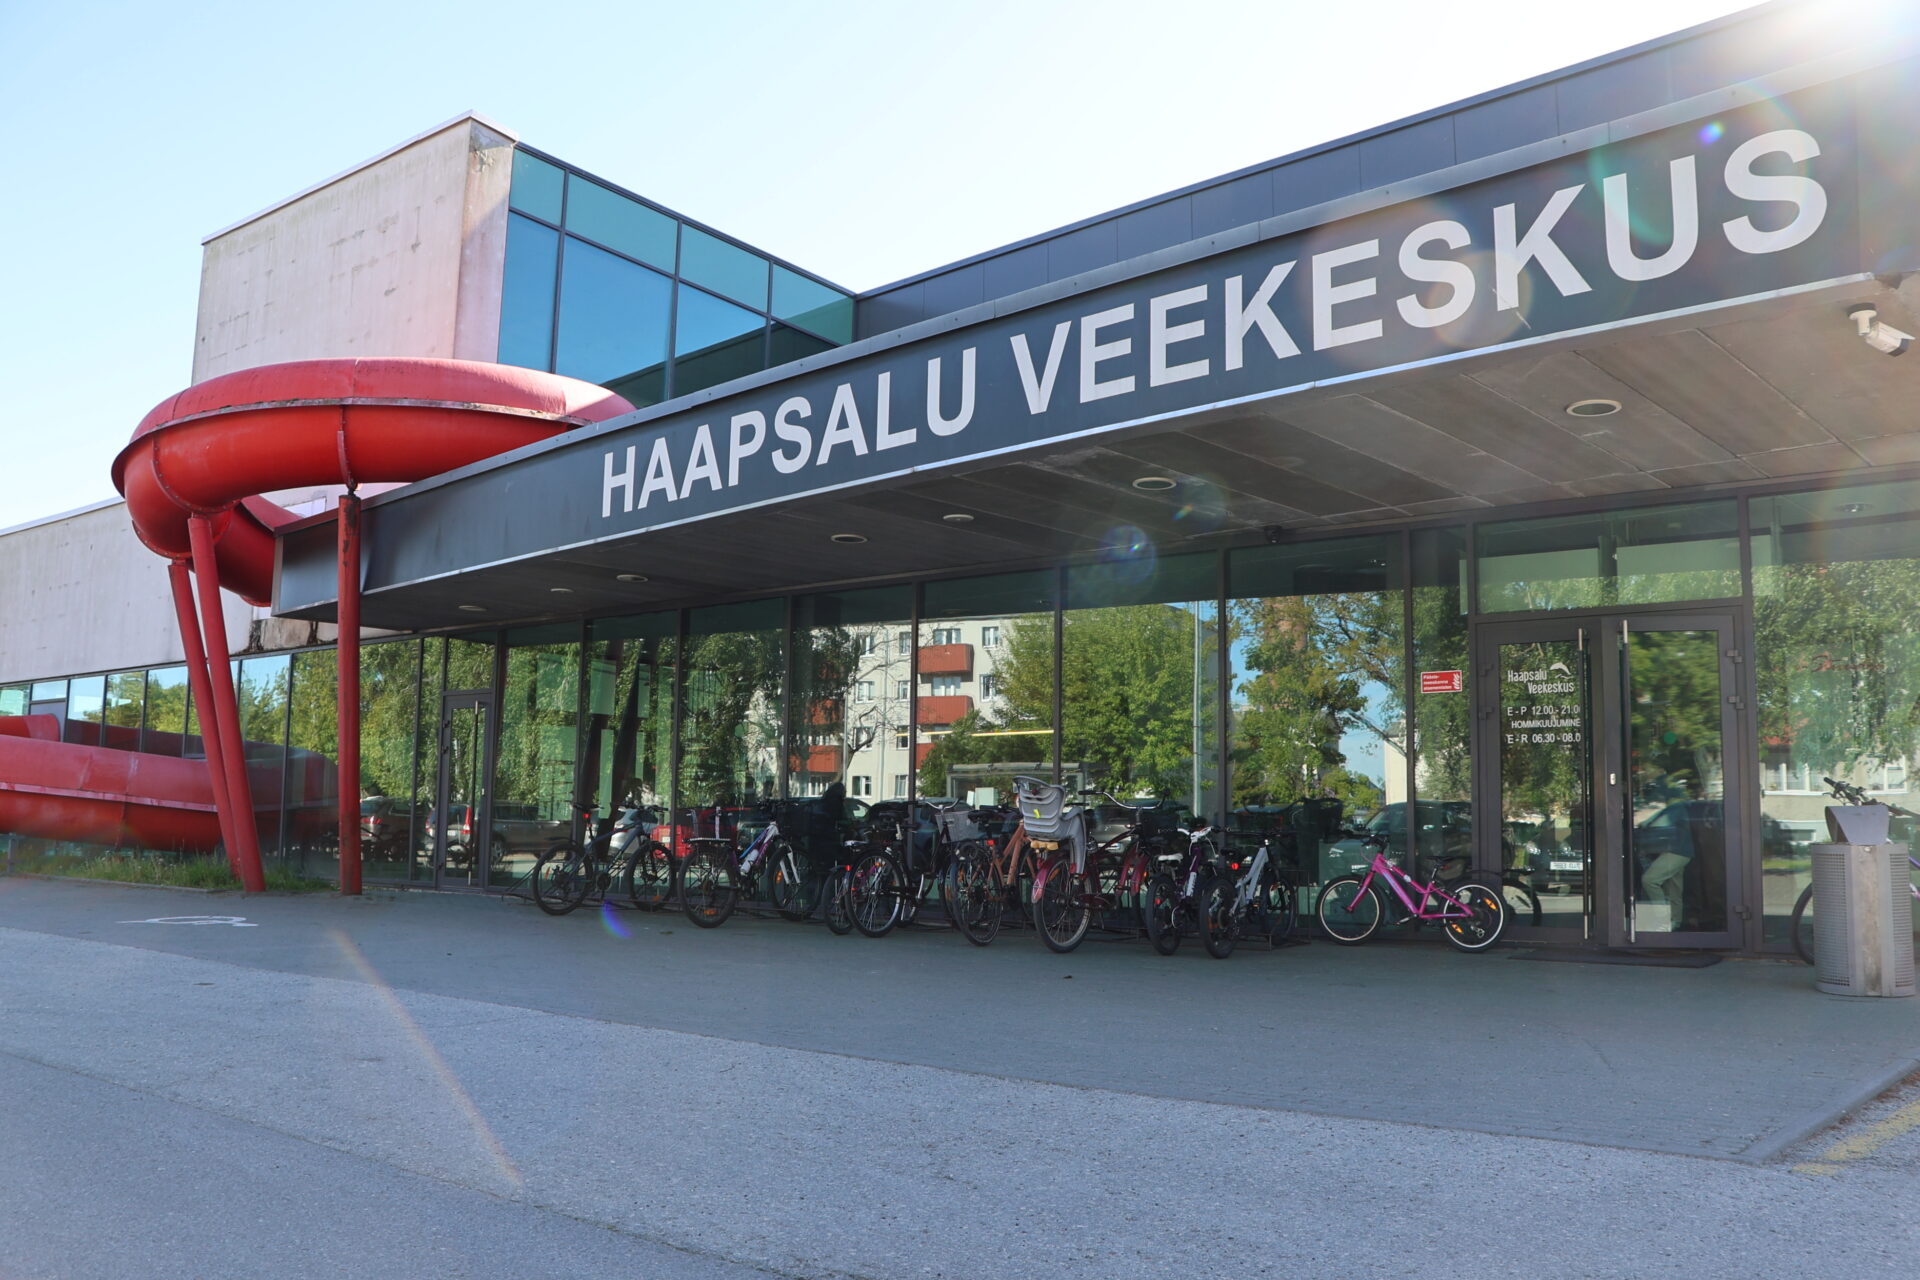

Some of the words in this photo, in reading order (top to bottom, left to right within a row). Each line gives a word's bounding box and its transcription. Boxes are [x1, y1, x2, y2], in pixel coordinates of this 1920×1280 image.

[601, 346, 977, 518] HAAPSALU
[1010, 129, 1828, 416] VEEKESKUS
[1507, 669, 1548, 683] Haapsalu
[1528, 682, 1575, 694] Veekeskus
[1507, 707, 1514, 716] E
[1521, 706, 1528, 716] P
[1532, 705, 1554, 716] 12.00
[1511, 719, 1581, 729] HOMMIKUUJUMINE
[1507, 734, 1514, 744] E
[1521, 733, 1528, 743] R
[1532, 733, 1555, 743] 06.30
